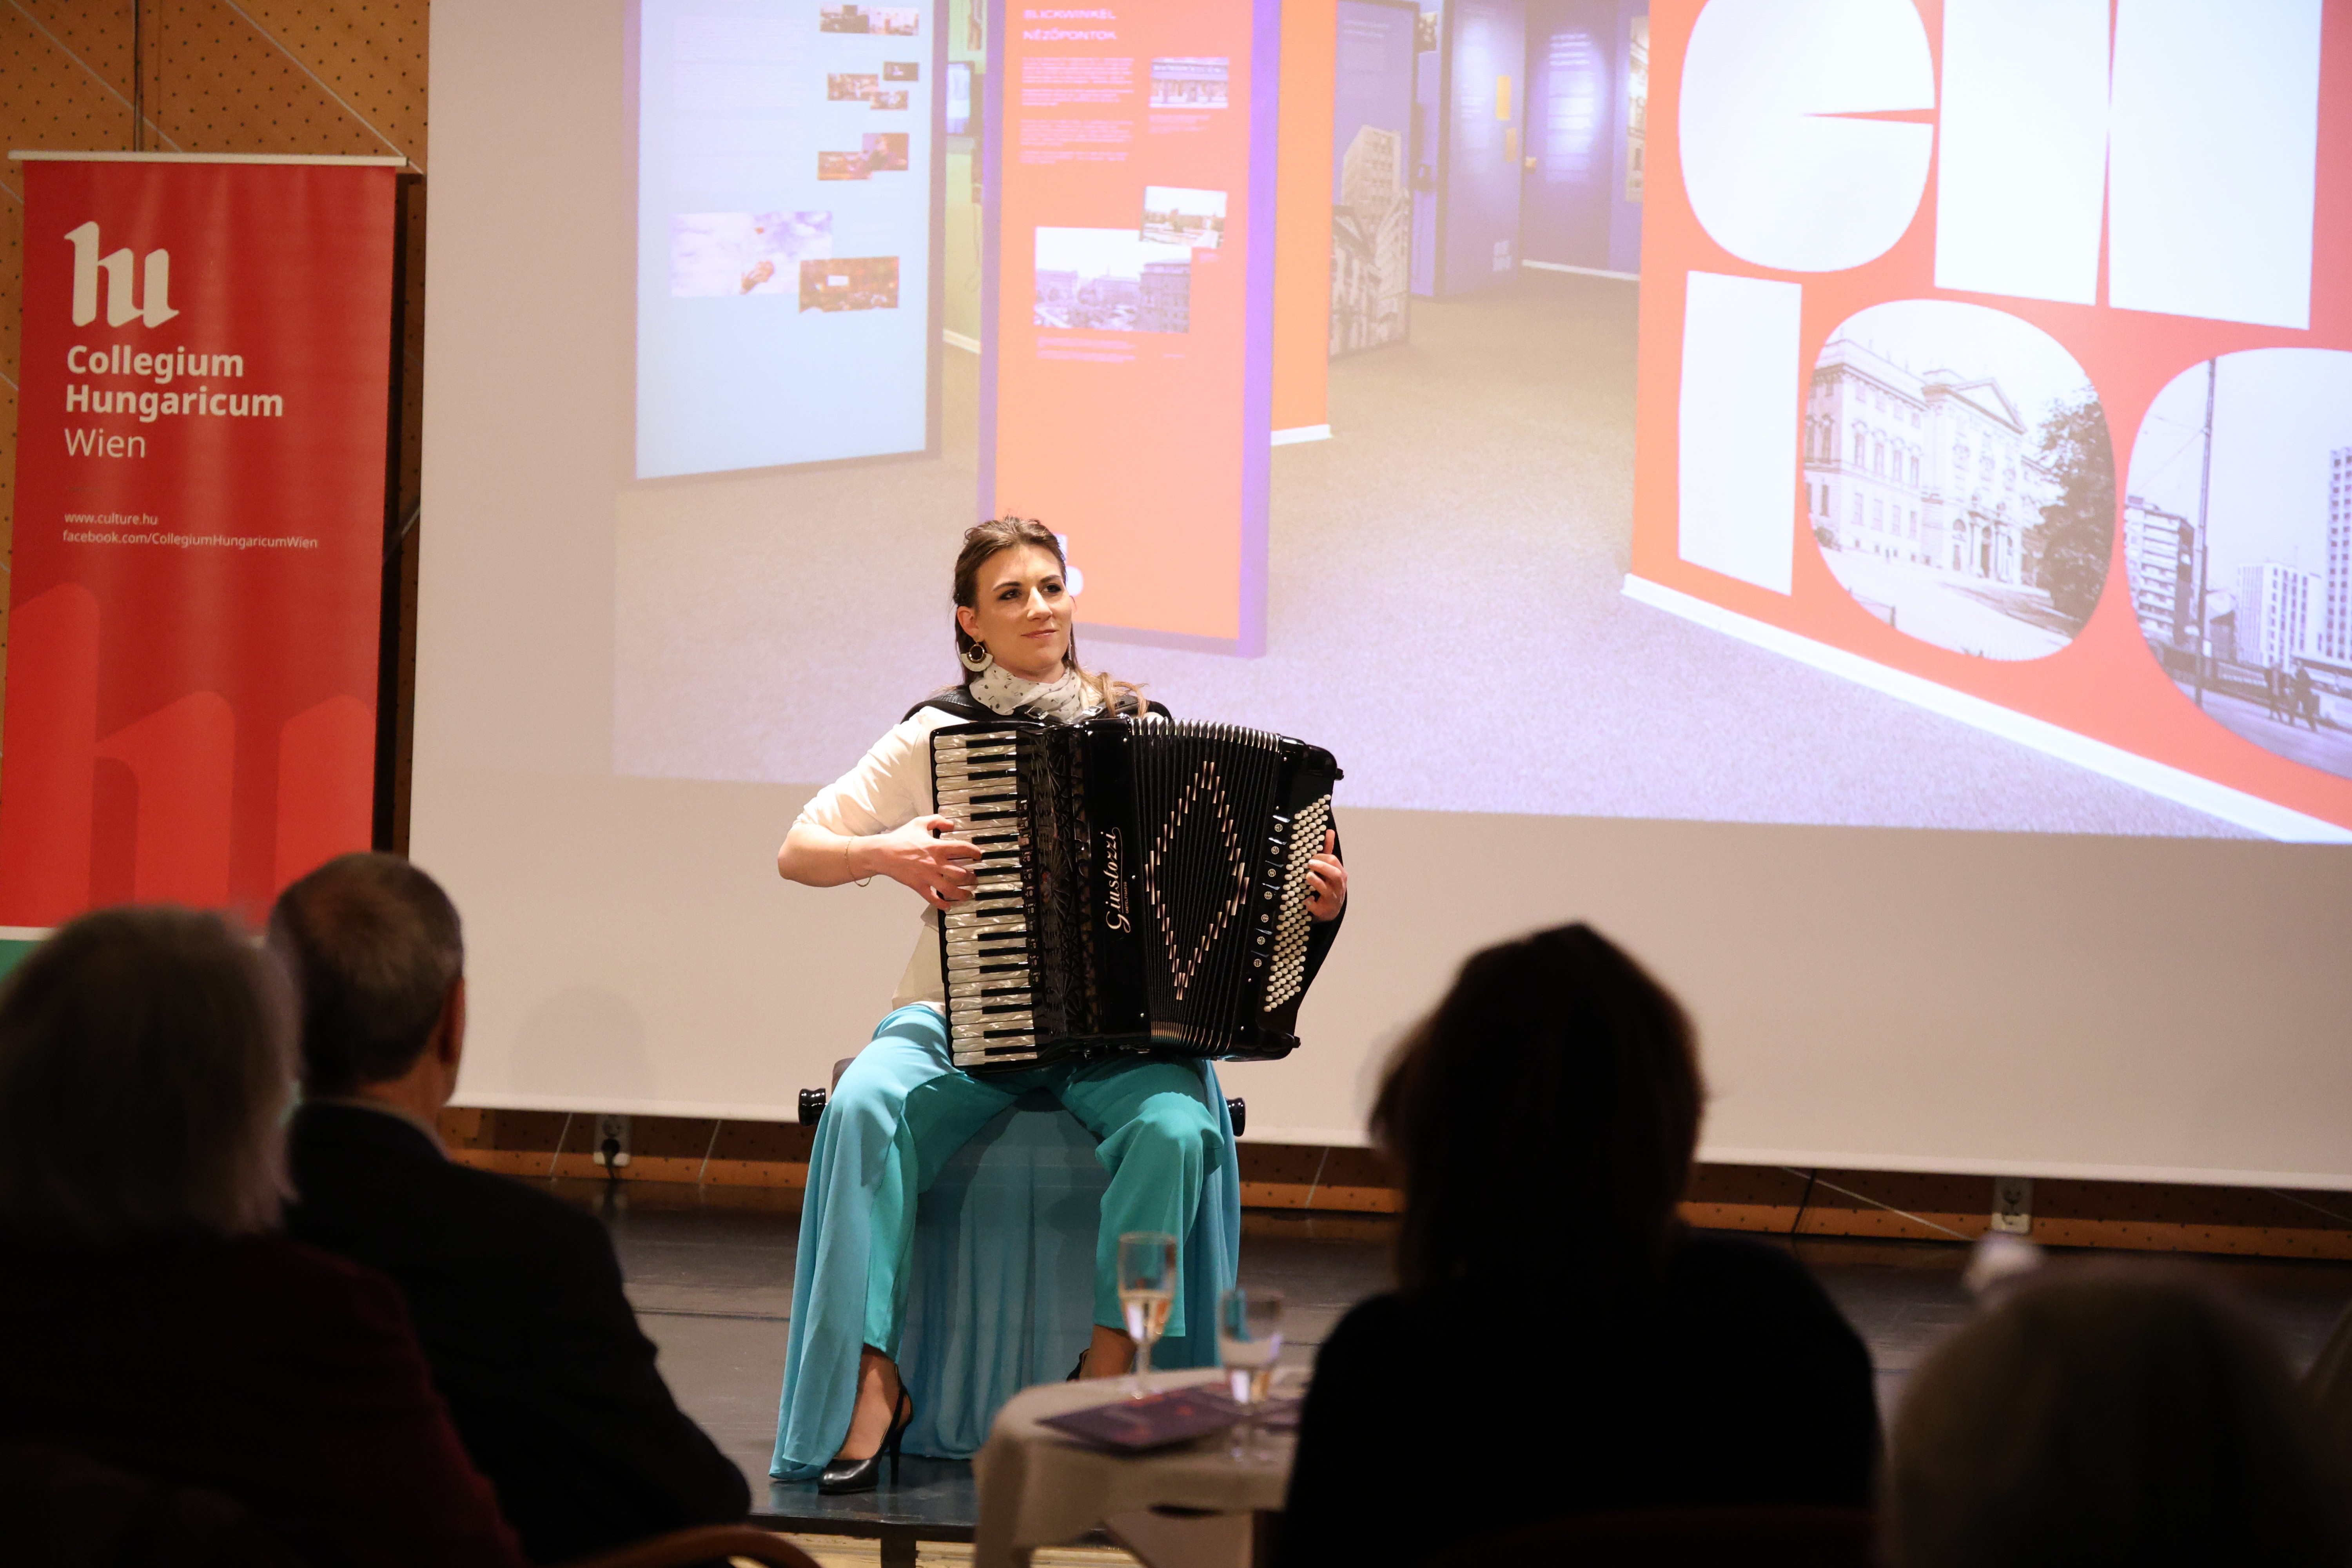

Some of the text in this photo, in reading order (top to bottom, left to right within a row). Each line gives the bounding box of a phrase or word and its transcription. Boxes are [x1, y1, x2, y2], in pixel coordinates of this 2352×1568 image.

[64, 220, 180, 328] hu
[67, 344, 244, 384] Collegium
[66, 384, 283, 423] Hungaricum
[64, 428, 145, 458] Wien
[64, 513, 158, 525] www.culture.hu
[63, 530, 318, 550] facebook.com/CollegiumHungaricumWien
[1100, 827, 1131, 933] Giustozzi
